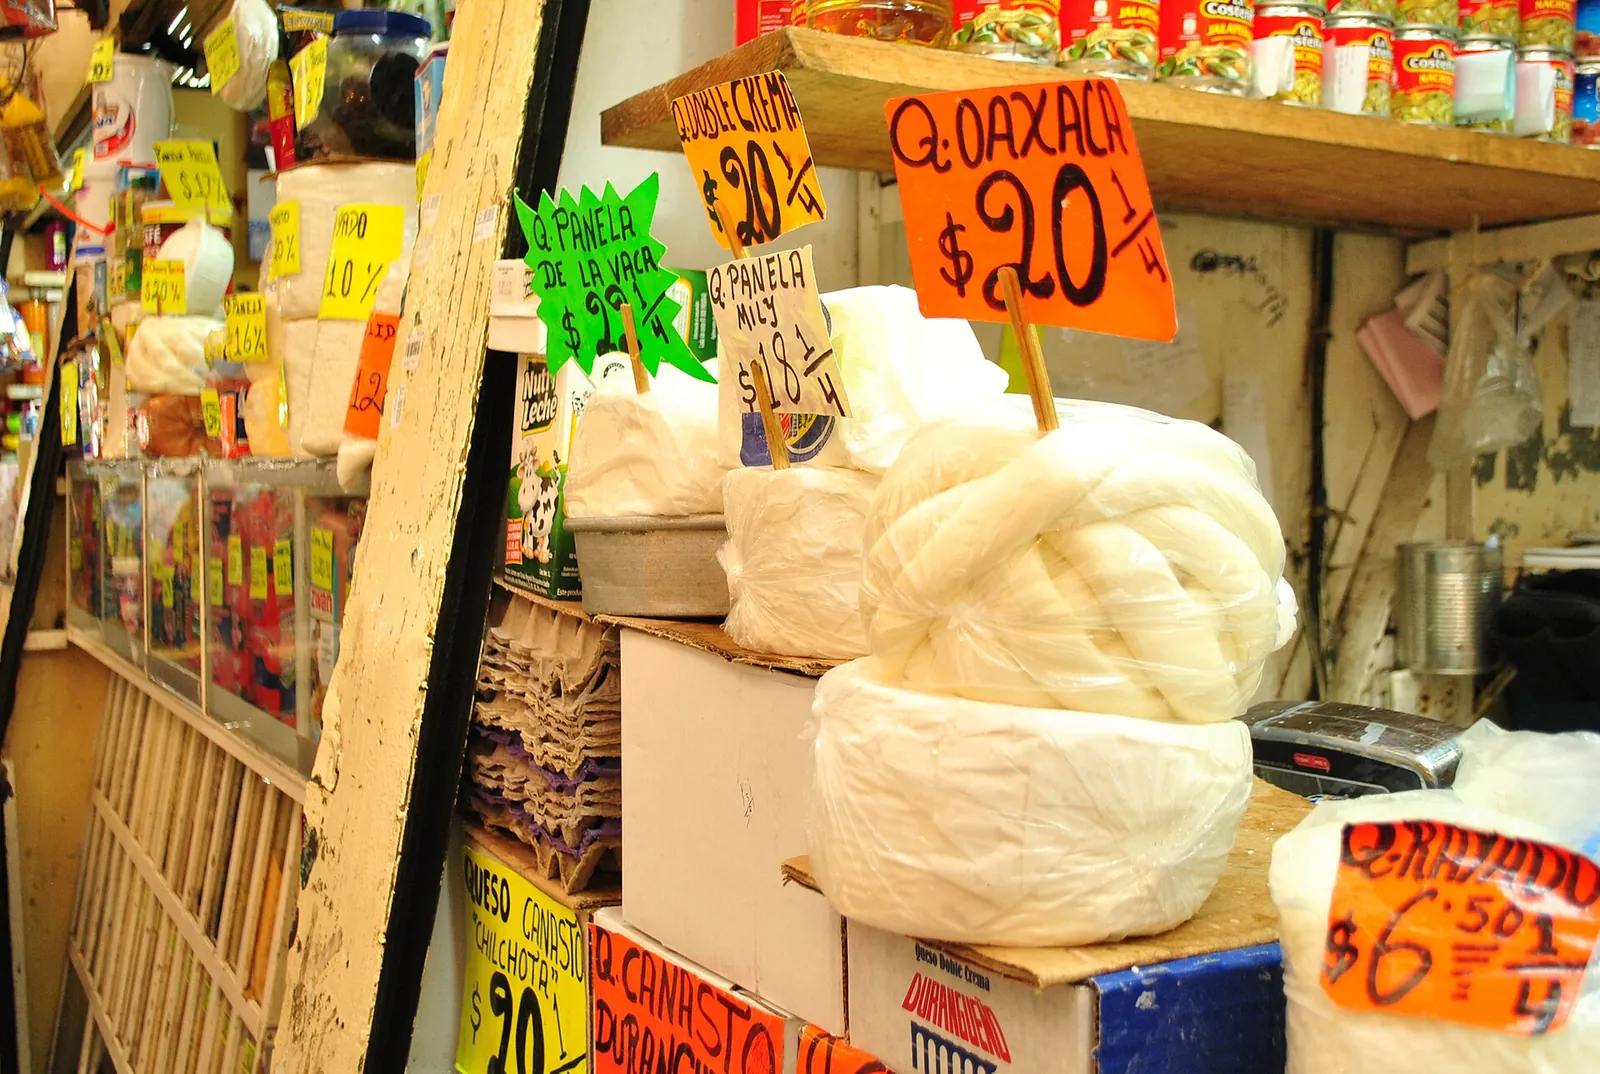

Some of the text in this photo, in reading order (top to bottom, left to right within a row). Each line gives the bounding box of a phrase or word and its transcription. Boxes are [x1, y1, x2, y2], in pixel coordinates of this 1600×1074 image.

[537, 259, 568, 291] DE
[577, 258, 606, 288] LA
[607, 245, 659, 286] VACA
[736, 295, 779, 332] MILY
[521, 391, 558, 430] Leche
[464, 854, 584, 983] QUESO CANASTO
